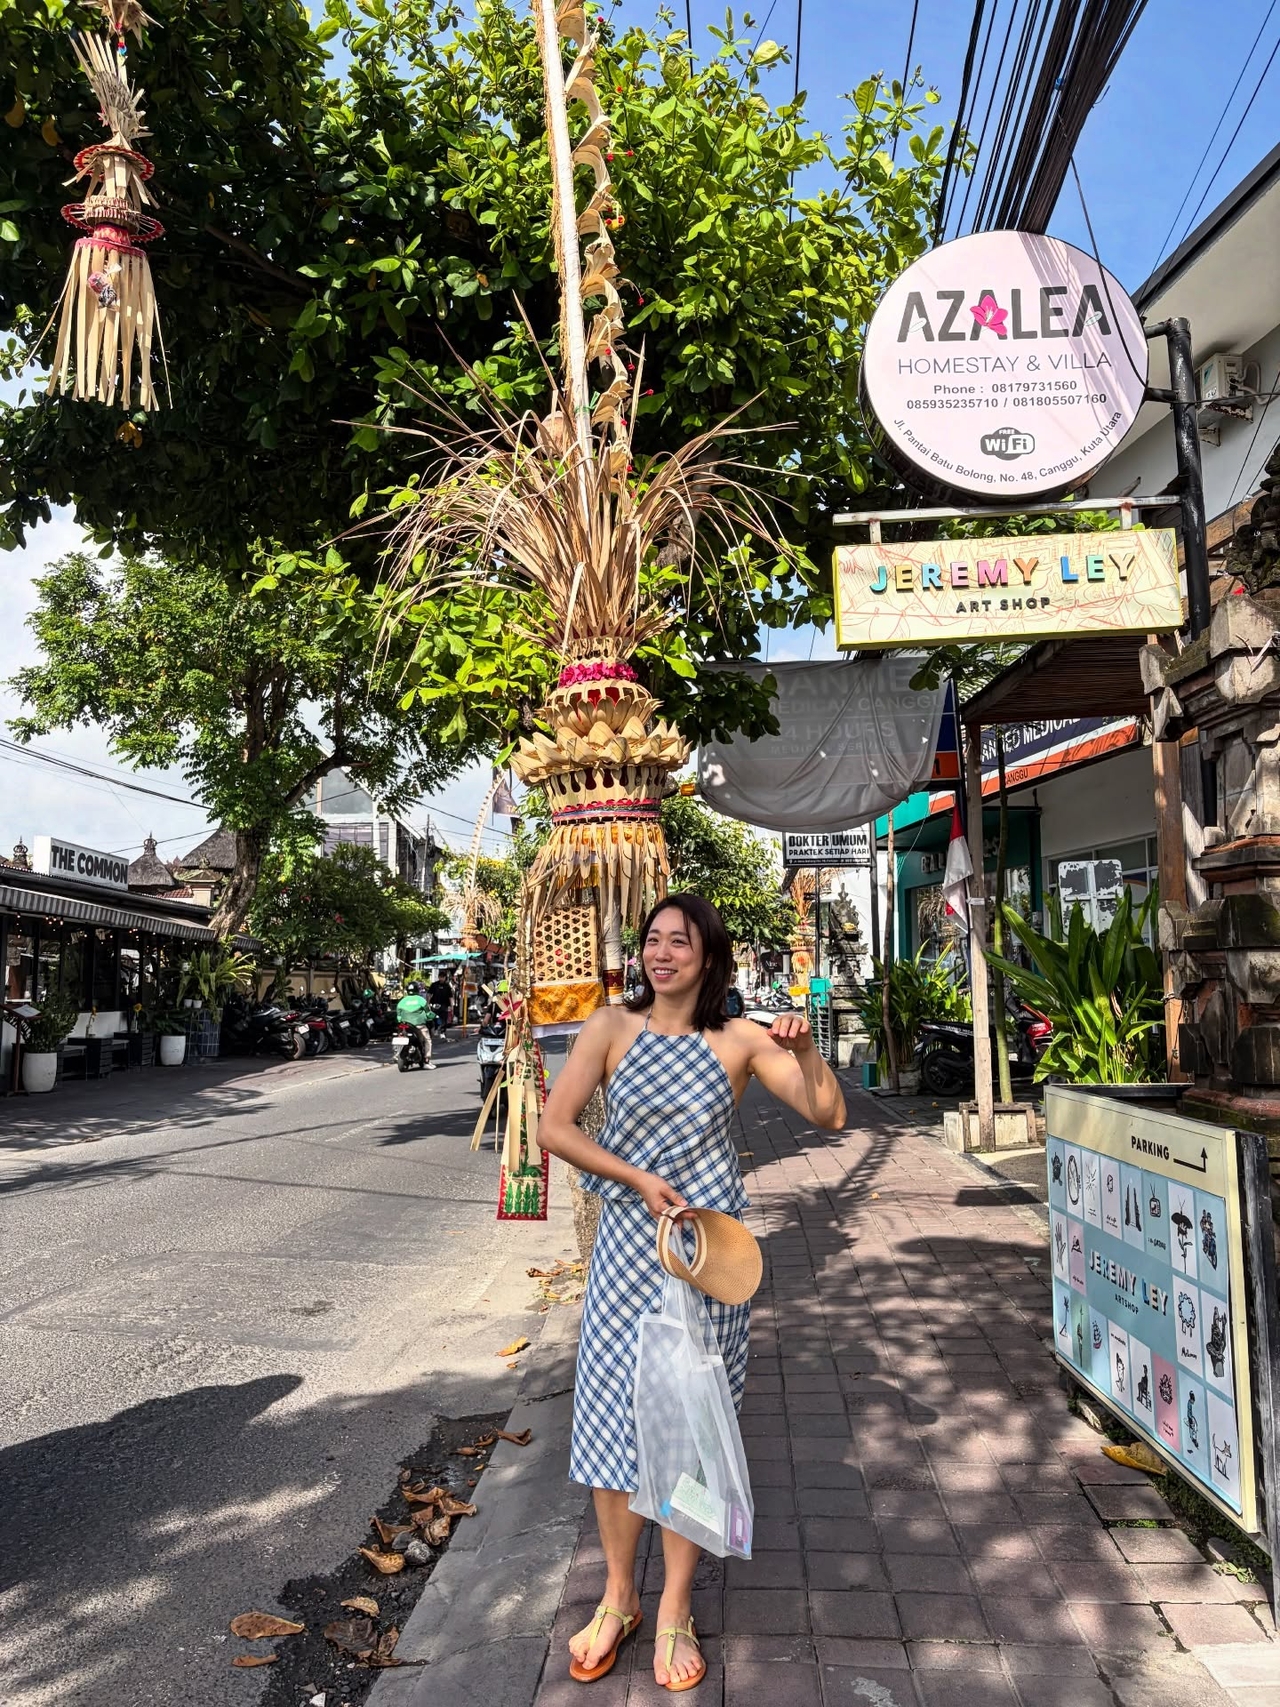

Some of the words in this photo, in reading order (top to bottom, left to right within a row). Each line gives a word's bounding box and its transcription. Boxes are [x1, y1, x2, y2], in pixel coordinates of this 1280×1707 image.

[897, 284, 1112, 343] AZALEA
[898, 356, 1018, 374] HOMESTAY
[1027, 355, 1040, 371] &
[1048, 352, 1112, 370] VILLA
[934, 385, 975, 394] Phone
[992, 381, 1077, 393] 08179731560
[907, 398, 998, 409] 085935235710
[1003, 397, 1008, 408] /
[1013, 393, 1107, 407] 081805507160
[903, 429, 932, 456] Pantai
[930, 452, 954, 470] Batu
[955, 464, 996, 484] Bolong,
[1000, 473, 1018, 482] No.
[1021, 471, 1037, 481] 48,
[1039, 455, 1083, 477] Canggu,
[1080, 436, 1104, 457] Kuta
[1099, 411, 1122, 437] Utara
[869, 557, 1040, 593] JEREMY
[1060, 553, 1136, 582] LEY
[956, 599, 992, 614] ART
[1000, 596, 1051, 611] SHOP
[788, 834, 829, 847] DOKTER
[831, 834, 867, 846] UMUM
[788, 848, 823, 856] PRAKTEK
[824, 848, 850, 856] SETIAP
[851, 847, 869, 855] HARI
[51, 845, 75, 871] THE
[77, 852, 128, 884] COMMON
[1131, 1135, 1170, 1160] PARKING
[1089, 1249, 1137, 1296] JEREMY
[1141, 1278, 1168, 1316] LEY
[1114, 1293, 1139, 1315] ARTSHOP
